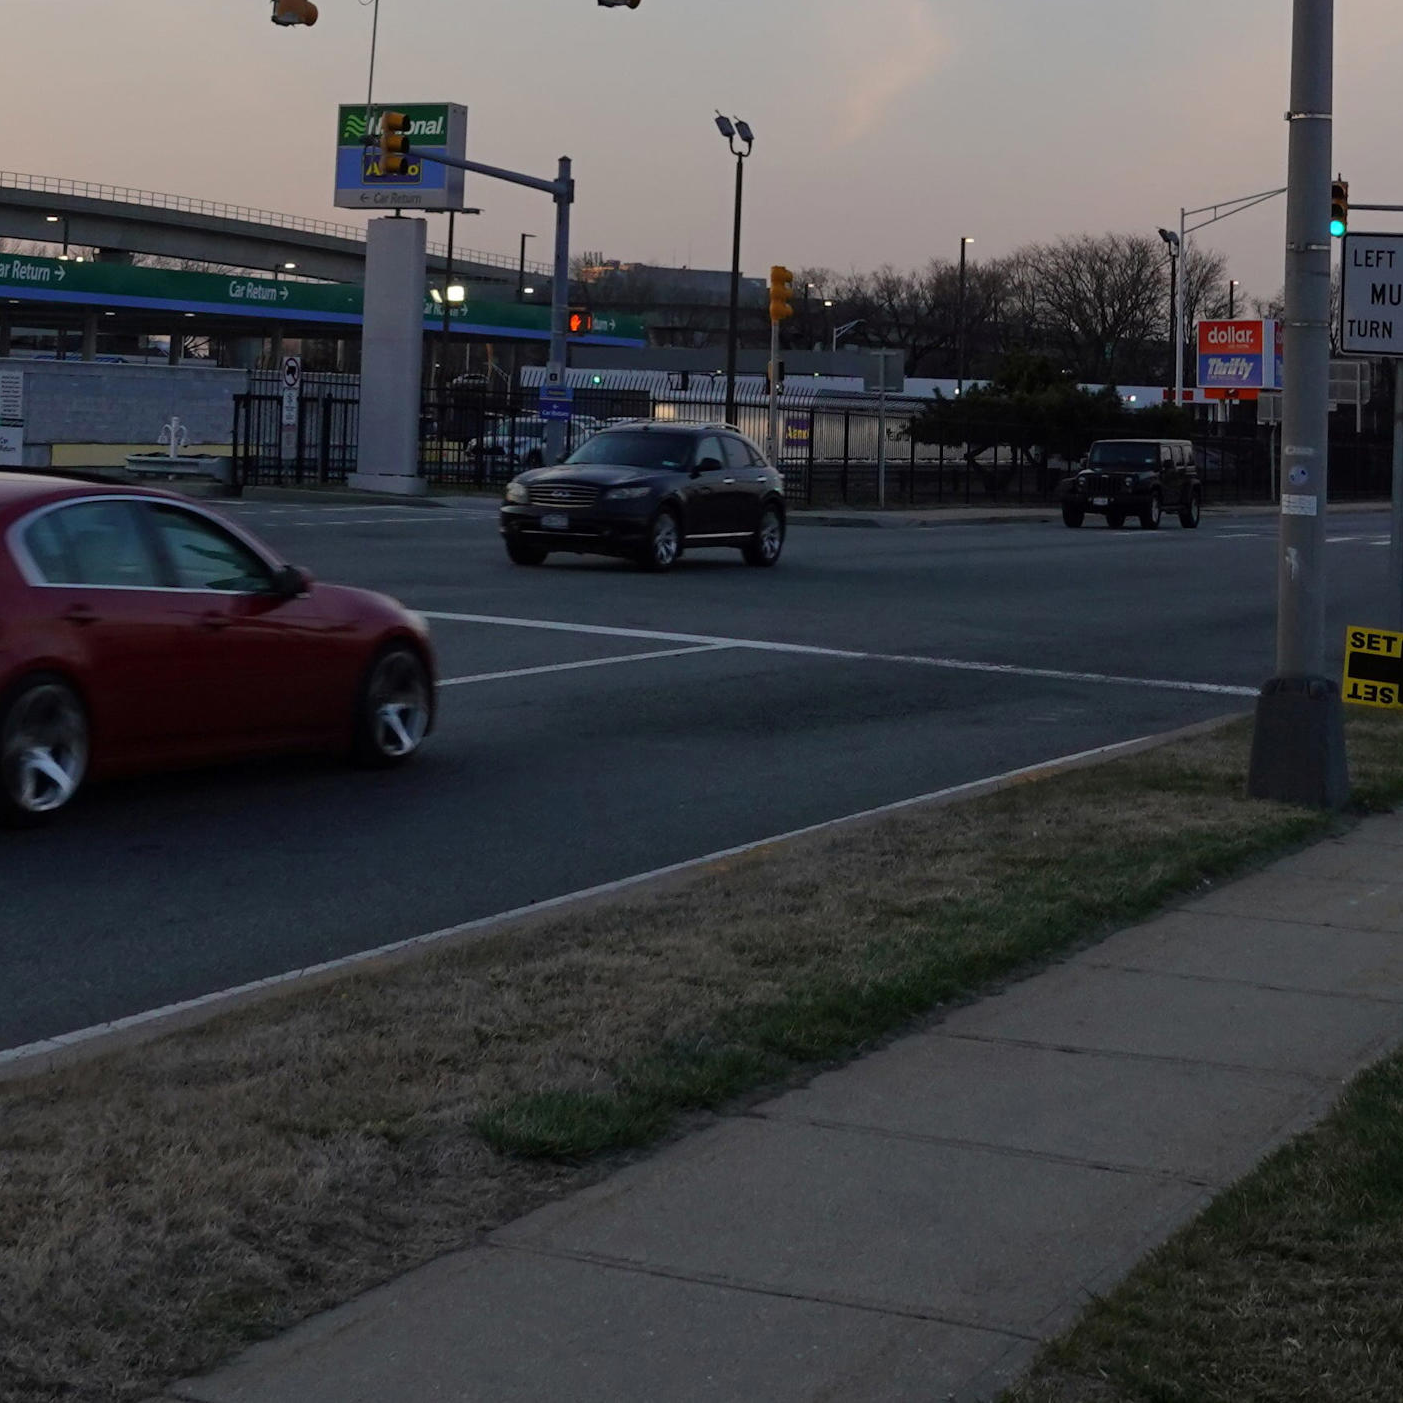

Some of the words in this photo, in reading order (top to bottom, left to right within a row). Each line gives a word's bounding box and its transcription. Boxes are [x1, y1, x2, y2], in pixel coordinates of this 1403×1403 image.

[374, 192, 390, 204] Car
[391, 193, 422, 205] Return
[1354, 249, 1396, 268] LEFT
[11, 260, 51, 283] Return
[229, 281, 246, 298] Car
[246, 282, 277, 301] Return
[1348, 319, 1392, 339] TURN
[1208, 357, 1254, 380] Thrifty
[1351, 631, 1398, 653] SET
